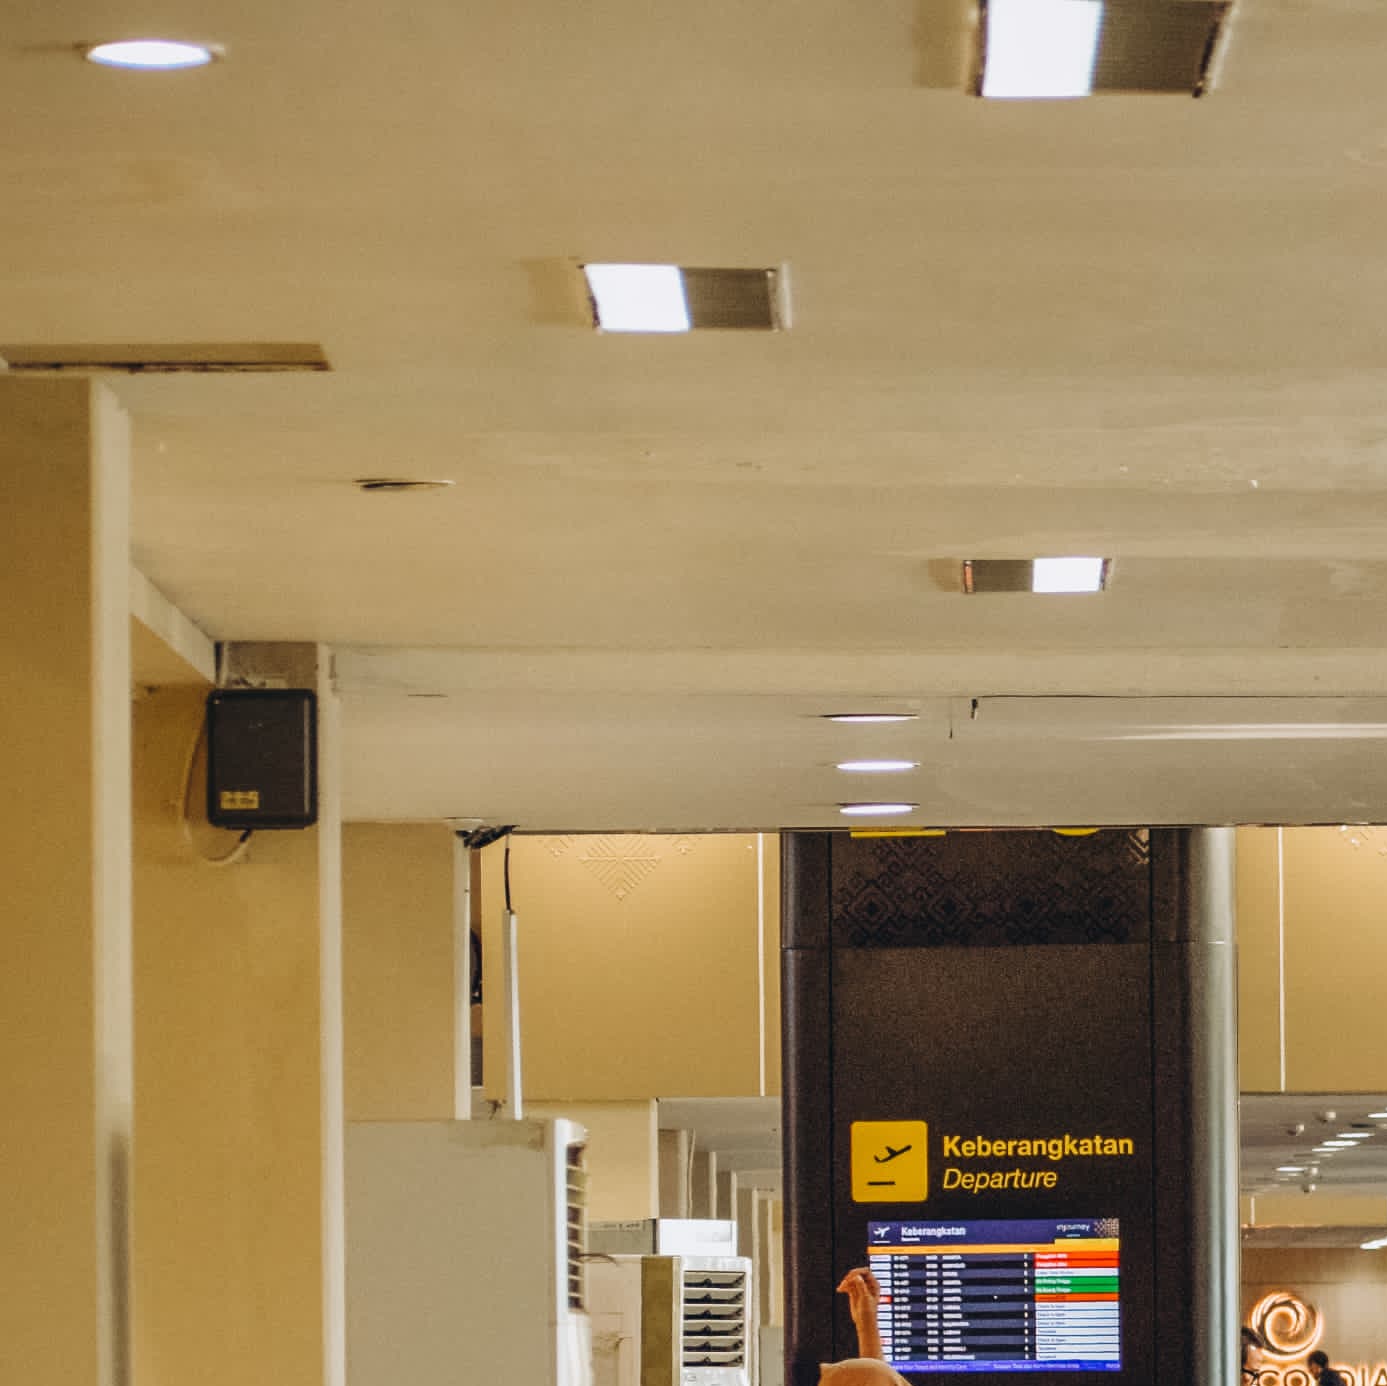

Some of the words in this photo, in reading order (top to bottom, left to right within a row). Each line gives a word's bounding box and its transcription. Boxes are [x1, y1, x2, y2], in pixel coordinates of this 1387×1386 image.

[943, 1133, 1135, 1161] Keberangkatan
[943, 1168, 1058, 1194] Departure
[900, 1226, 967, 1238] Keberangkatan
